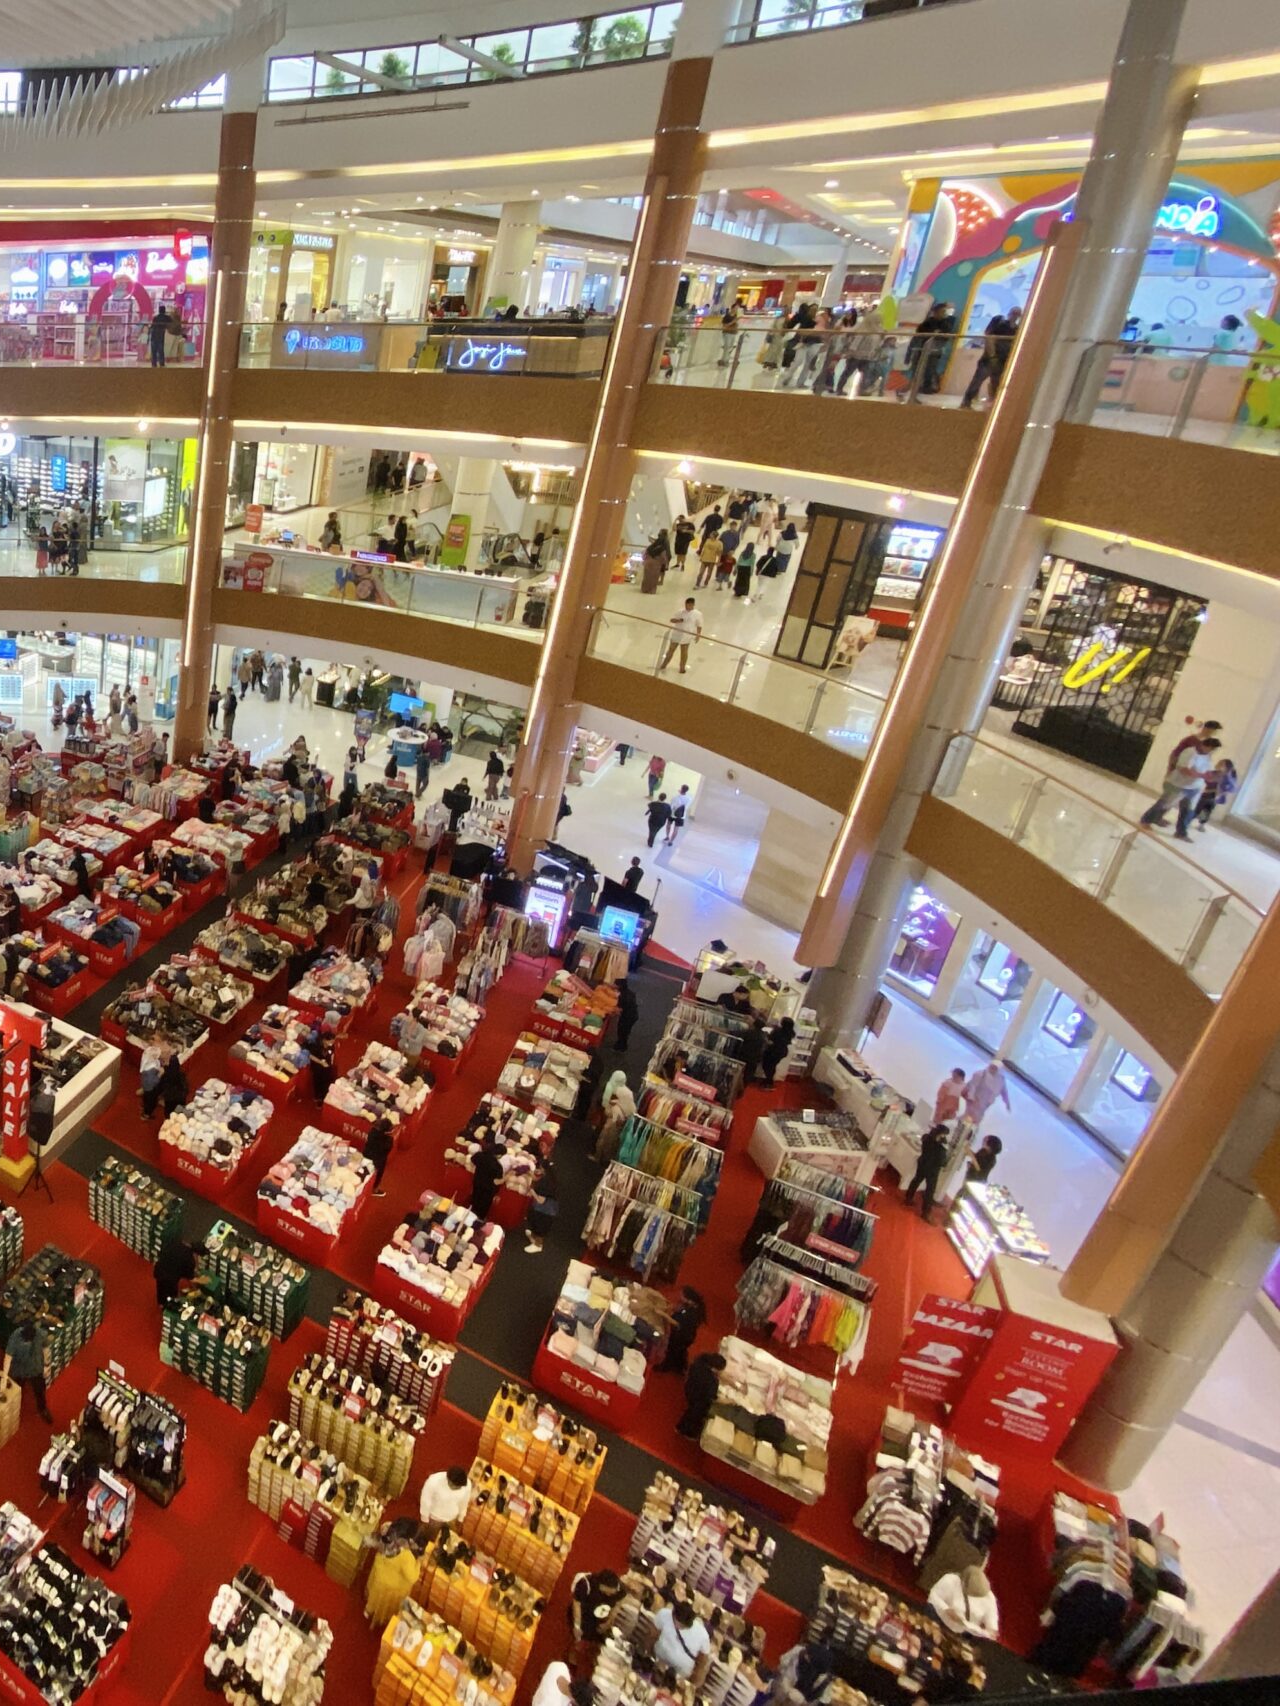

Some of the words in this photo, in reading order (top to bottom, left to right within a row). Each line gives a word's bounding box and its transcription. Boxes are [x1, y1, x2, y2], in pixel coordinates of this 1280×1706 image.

[534, 1021, 560, 1038] STAR
[563, 1029, 590, 1046] STAR
[242, 1073, 265, 1091] STAR
[4, 1060, 16, 1137] SALE
[177, 1158, 202, 1178] STAR
[277, 1218, 306, 1239] STAR
[398, 1290, 433, 1314] STAR
[936, 1297, 986, 1317] STAR
[913, 1310, 994, 1339] BAZAAR
[1030, 1331, 1083, 1354] STAR
[1021, 1356, 1064, 1376] ROOM
[560, 1370, 611, 1407] STAR
